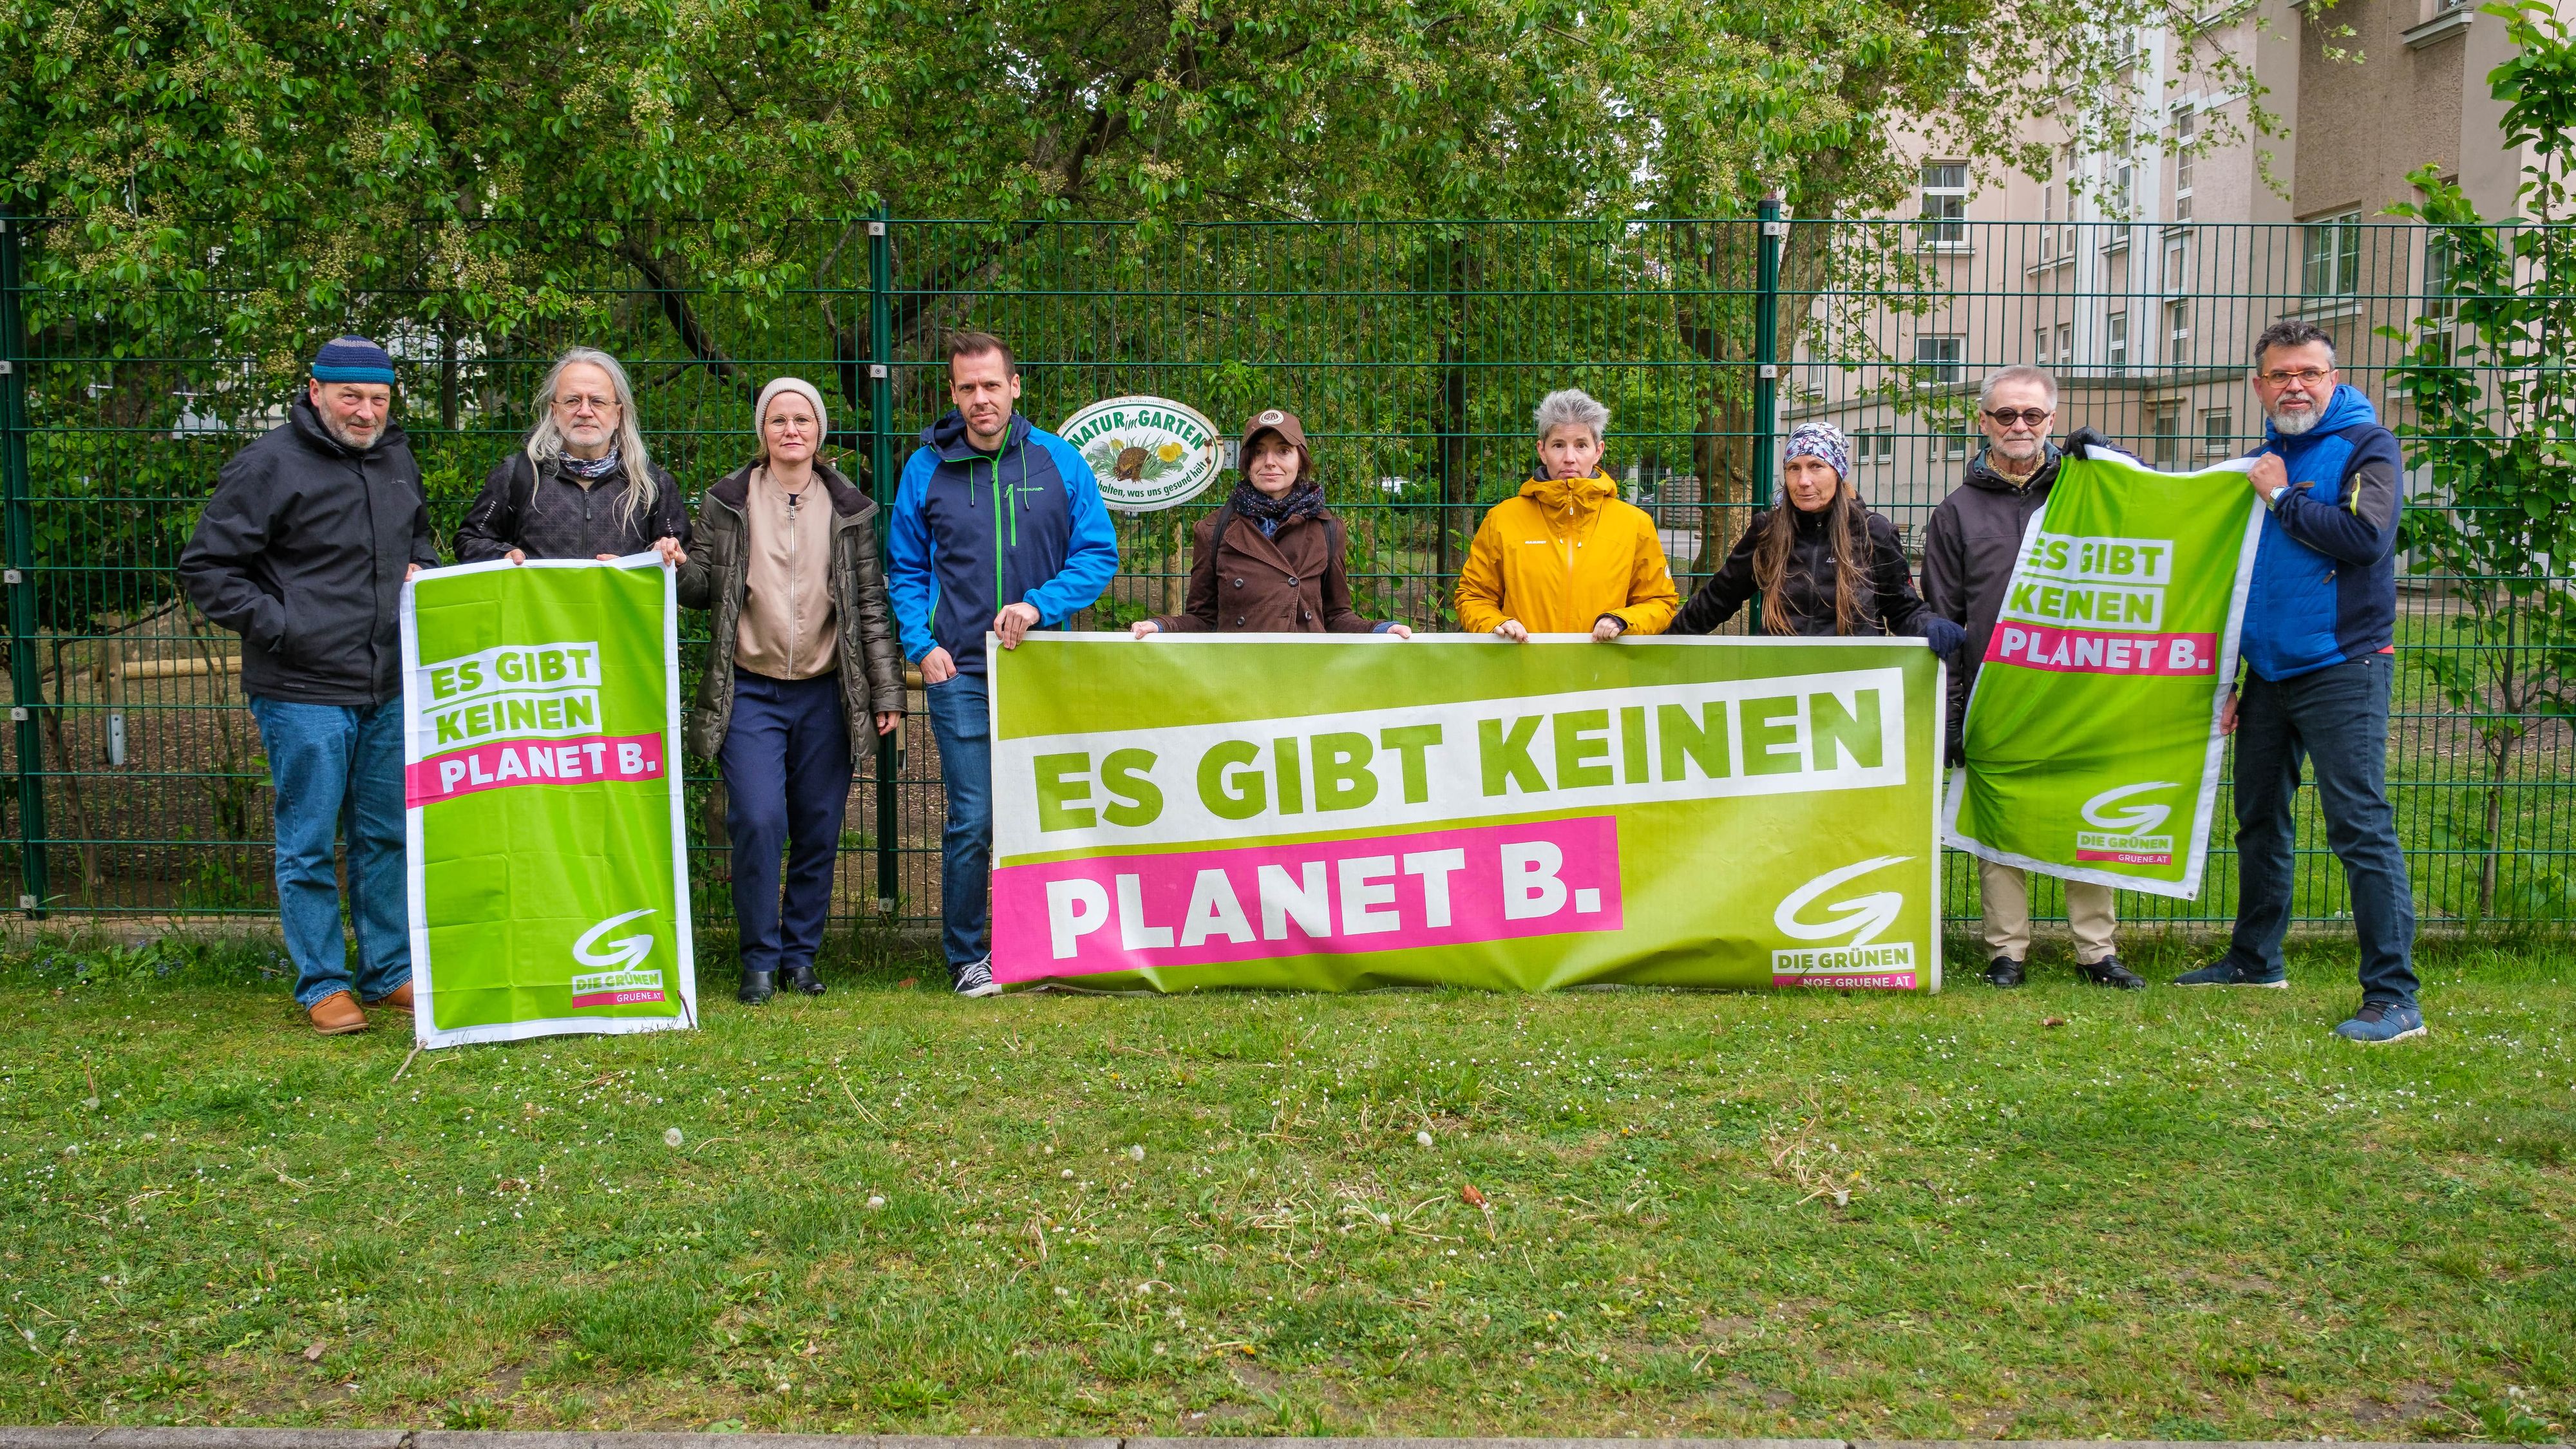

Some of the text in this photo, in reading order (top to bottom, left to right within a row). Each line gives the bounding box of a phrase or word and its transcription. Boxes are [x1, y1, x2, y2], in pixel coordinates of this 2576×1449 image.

[1068, 411, 1125, 451] NATUR
[1125, 414, 1139, 431] im
[1139, 410, 1207, 451] GARTEN
[1127, 489, 1144, 498] was
[1147, 488, 1162, 497] uns
[1164, 472, 1192, 496] gesund
[1189, 461, 1206, 478] hält
[2079, 543, 2164, 576] GIBT
[2000, 627, 2209, 668] PLANET B.
[430, 649, 591, 701] ES GIBT
[436, 696, 594, 745] KEINEN
[439, 743, 656, 793] PLANET B.
[1033, 688, 1884, 833] ES GIBT KEINEN
[2080, 835, 2168, 849] DIE GRÜNEN
[2118, 854, 2168, 864] GRUENE.AT
[1045, 840, 1602, 960] PLANET B.
[1777, 947, 1909, 969] DIE GRÜNEN
[576, 971, 659, 991] DIE GRÜNEN
[616, 992, 661, 1003] GRUENE.AT
